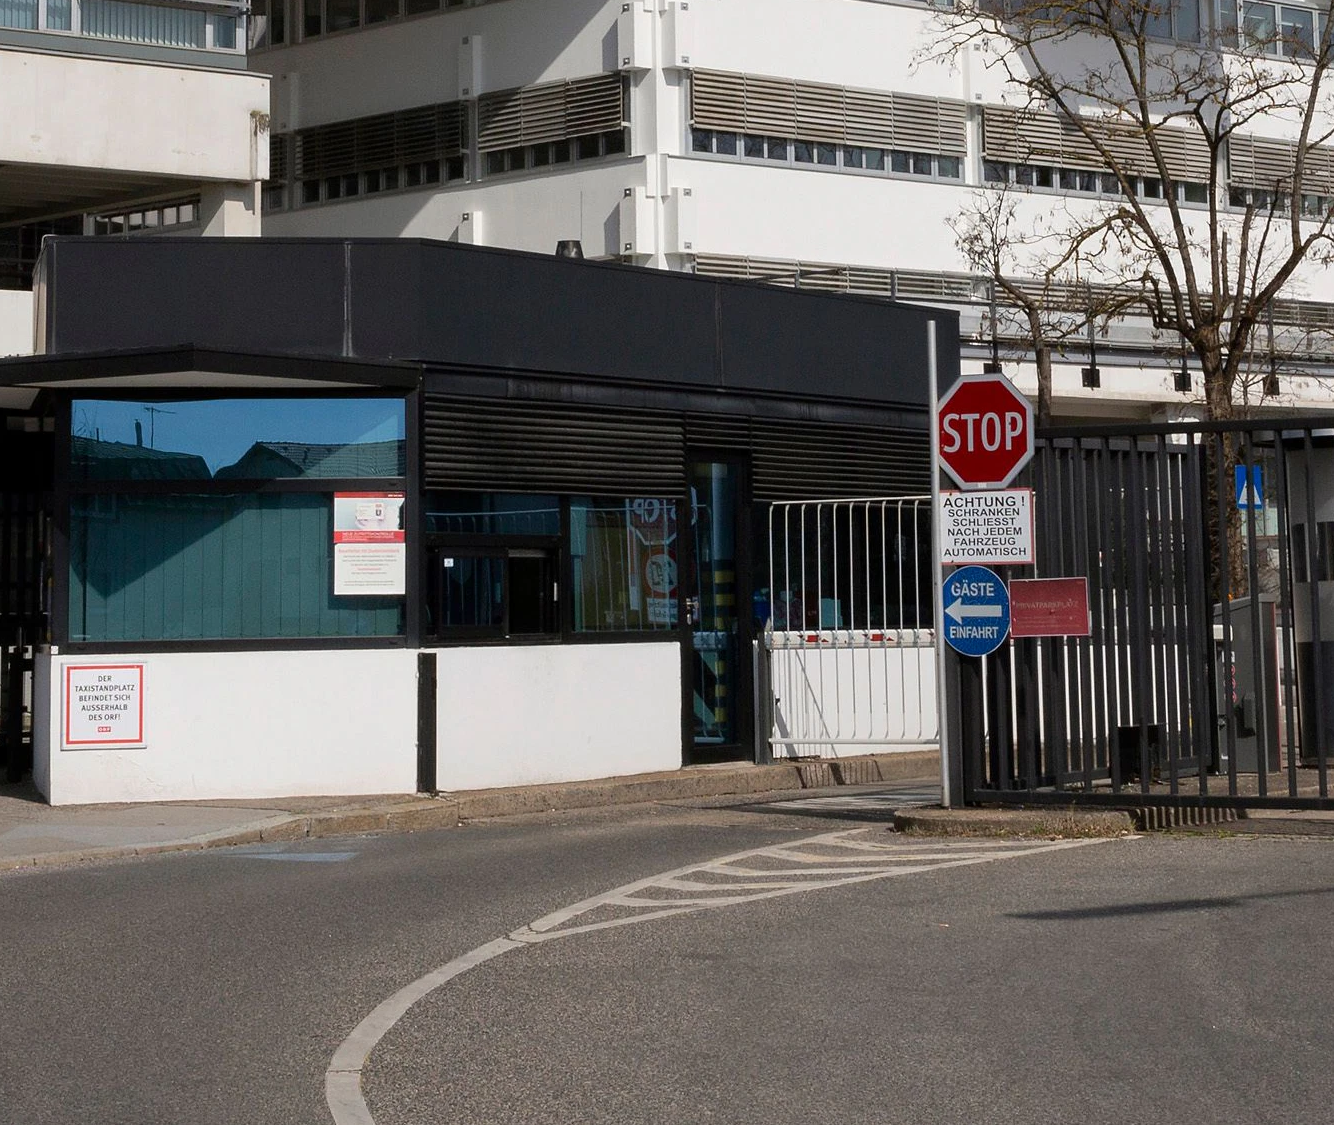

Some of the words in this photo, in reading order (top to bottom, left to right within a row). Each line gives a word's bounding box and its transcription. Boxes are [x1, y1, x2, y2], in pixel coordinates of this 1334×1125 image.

[943, 412, 1023, 453] STOP
[943, 496, 1016, 508] ACHTUNG
[1021, 496, 1025, 506] !
[948, 508, 1020, 517] SCHRANKEN
[952, 518, 1016, 527] SCHLIESST
[947, 528, 980, 536] NACH
[983, 527, 1022, 536] JEDEM
[953, 537, 1016, 547] FAHRZEUG
[943, 547, 1027, 557] AUTOMATISCH
[951, 579, 995, 597] GÄSTE
[949, 626, 999, 639] EINFAHRT
